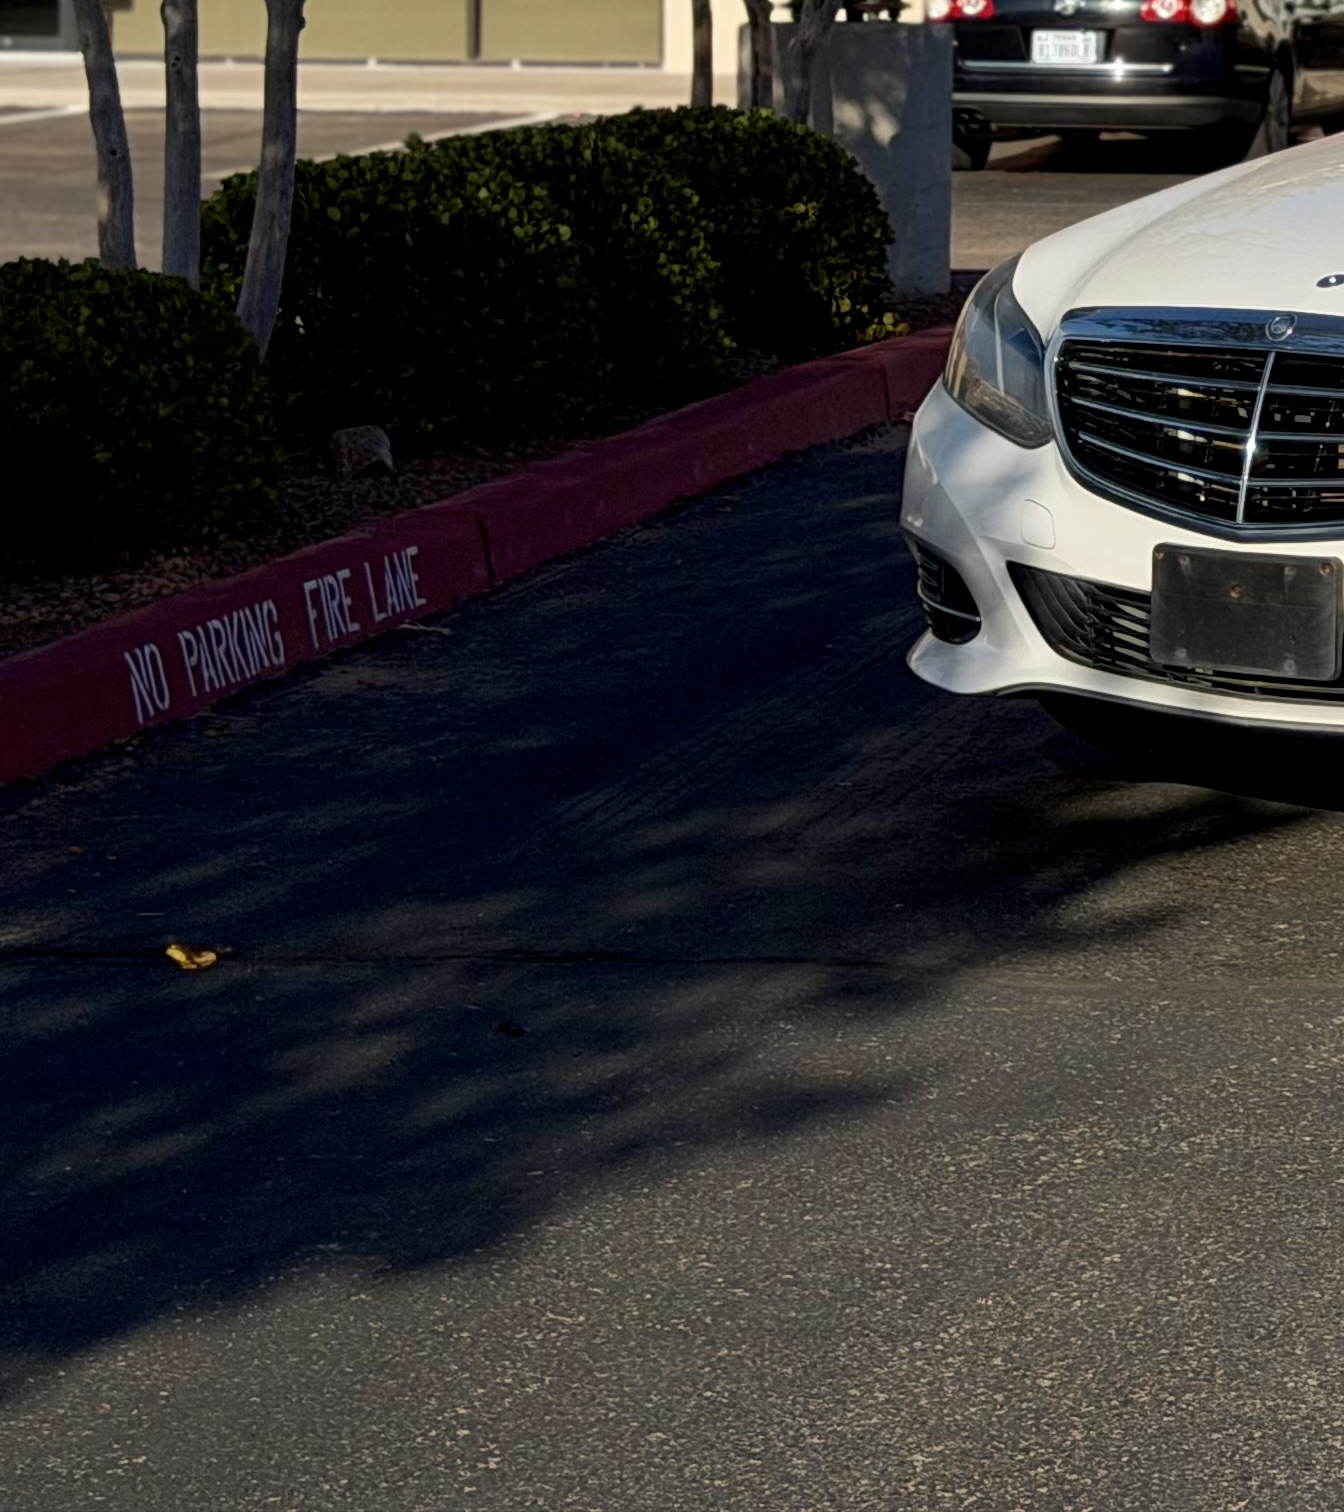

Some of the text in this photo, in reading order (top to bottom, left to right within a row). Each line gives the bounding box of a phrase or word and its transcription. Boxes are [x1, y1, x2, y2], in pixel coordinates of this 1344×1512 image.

[124, 546, 427, 725] NO PARKING FIRE LANE
